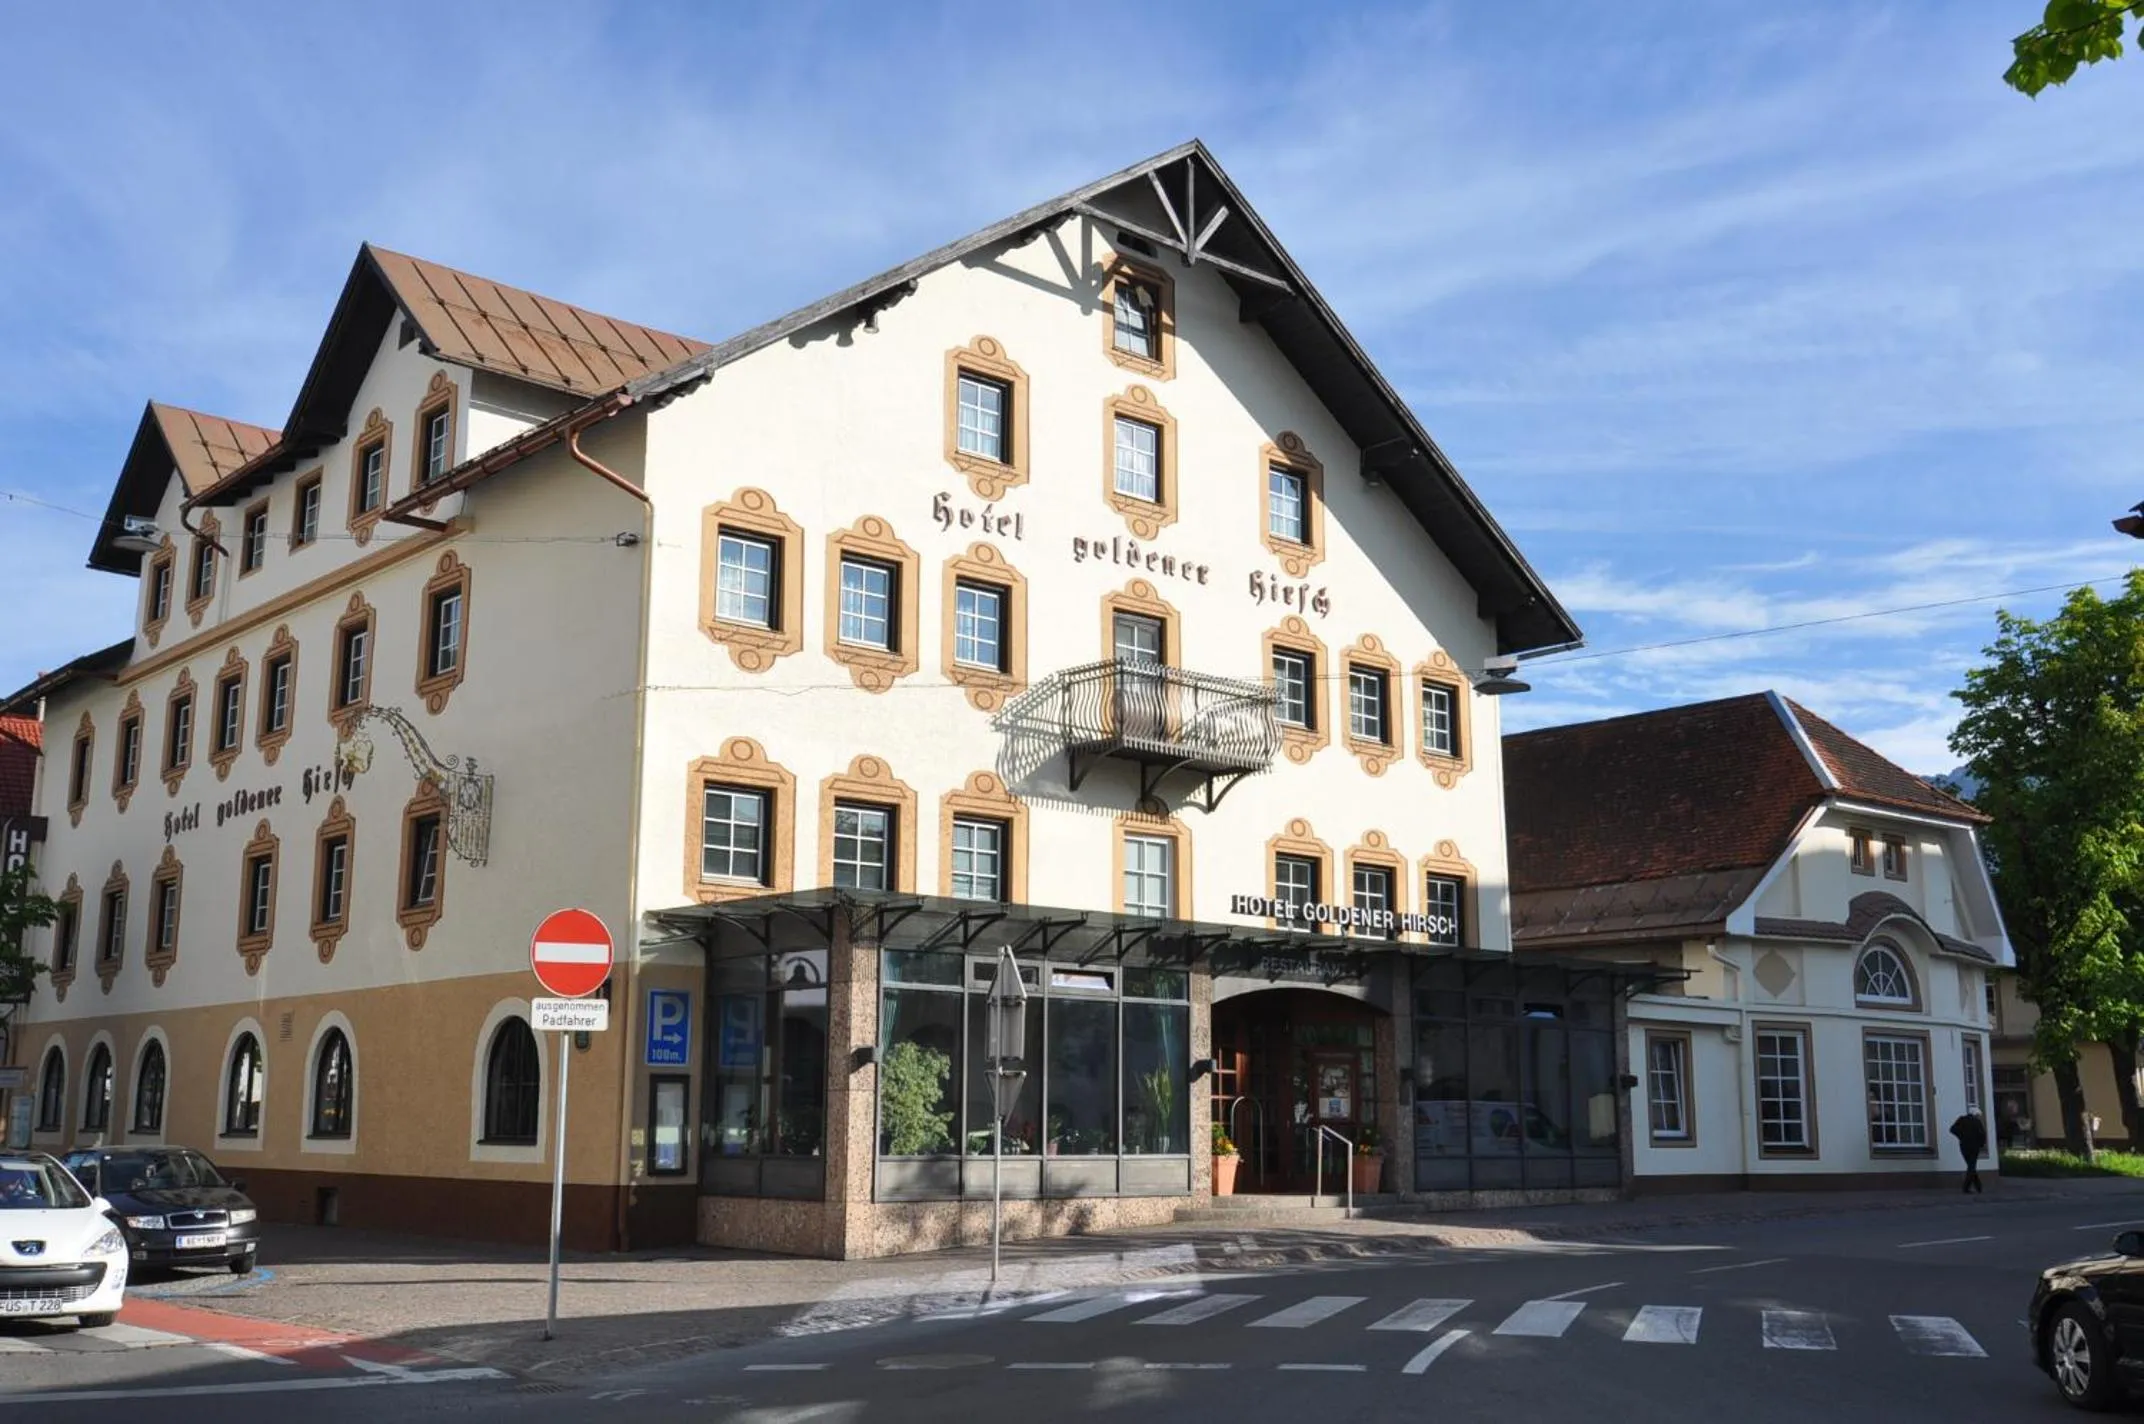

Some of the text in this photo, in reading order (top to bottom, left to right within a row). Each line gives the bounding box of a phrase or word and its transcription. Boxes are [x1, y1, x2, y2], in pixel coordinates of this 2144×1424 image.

[933, 491, 1331, 619] Hotel goldener Hirsch
[164, 803, 201, 843] Hotel
[217, 785, 282, 827] goldener
[1236, 895, 1456, 935] HOTEL GOLDENER HIRSCH
[536, 1002, 605, 1012] ausgenommen
[653, 995, 685, 1041] P
[39, 1299, 61, 1311] 228
